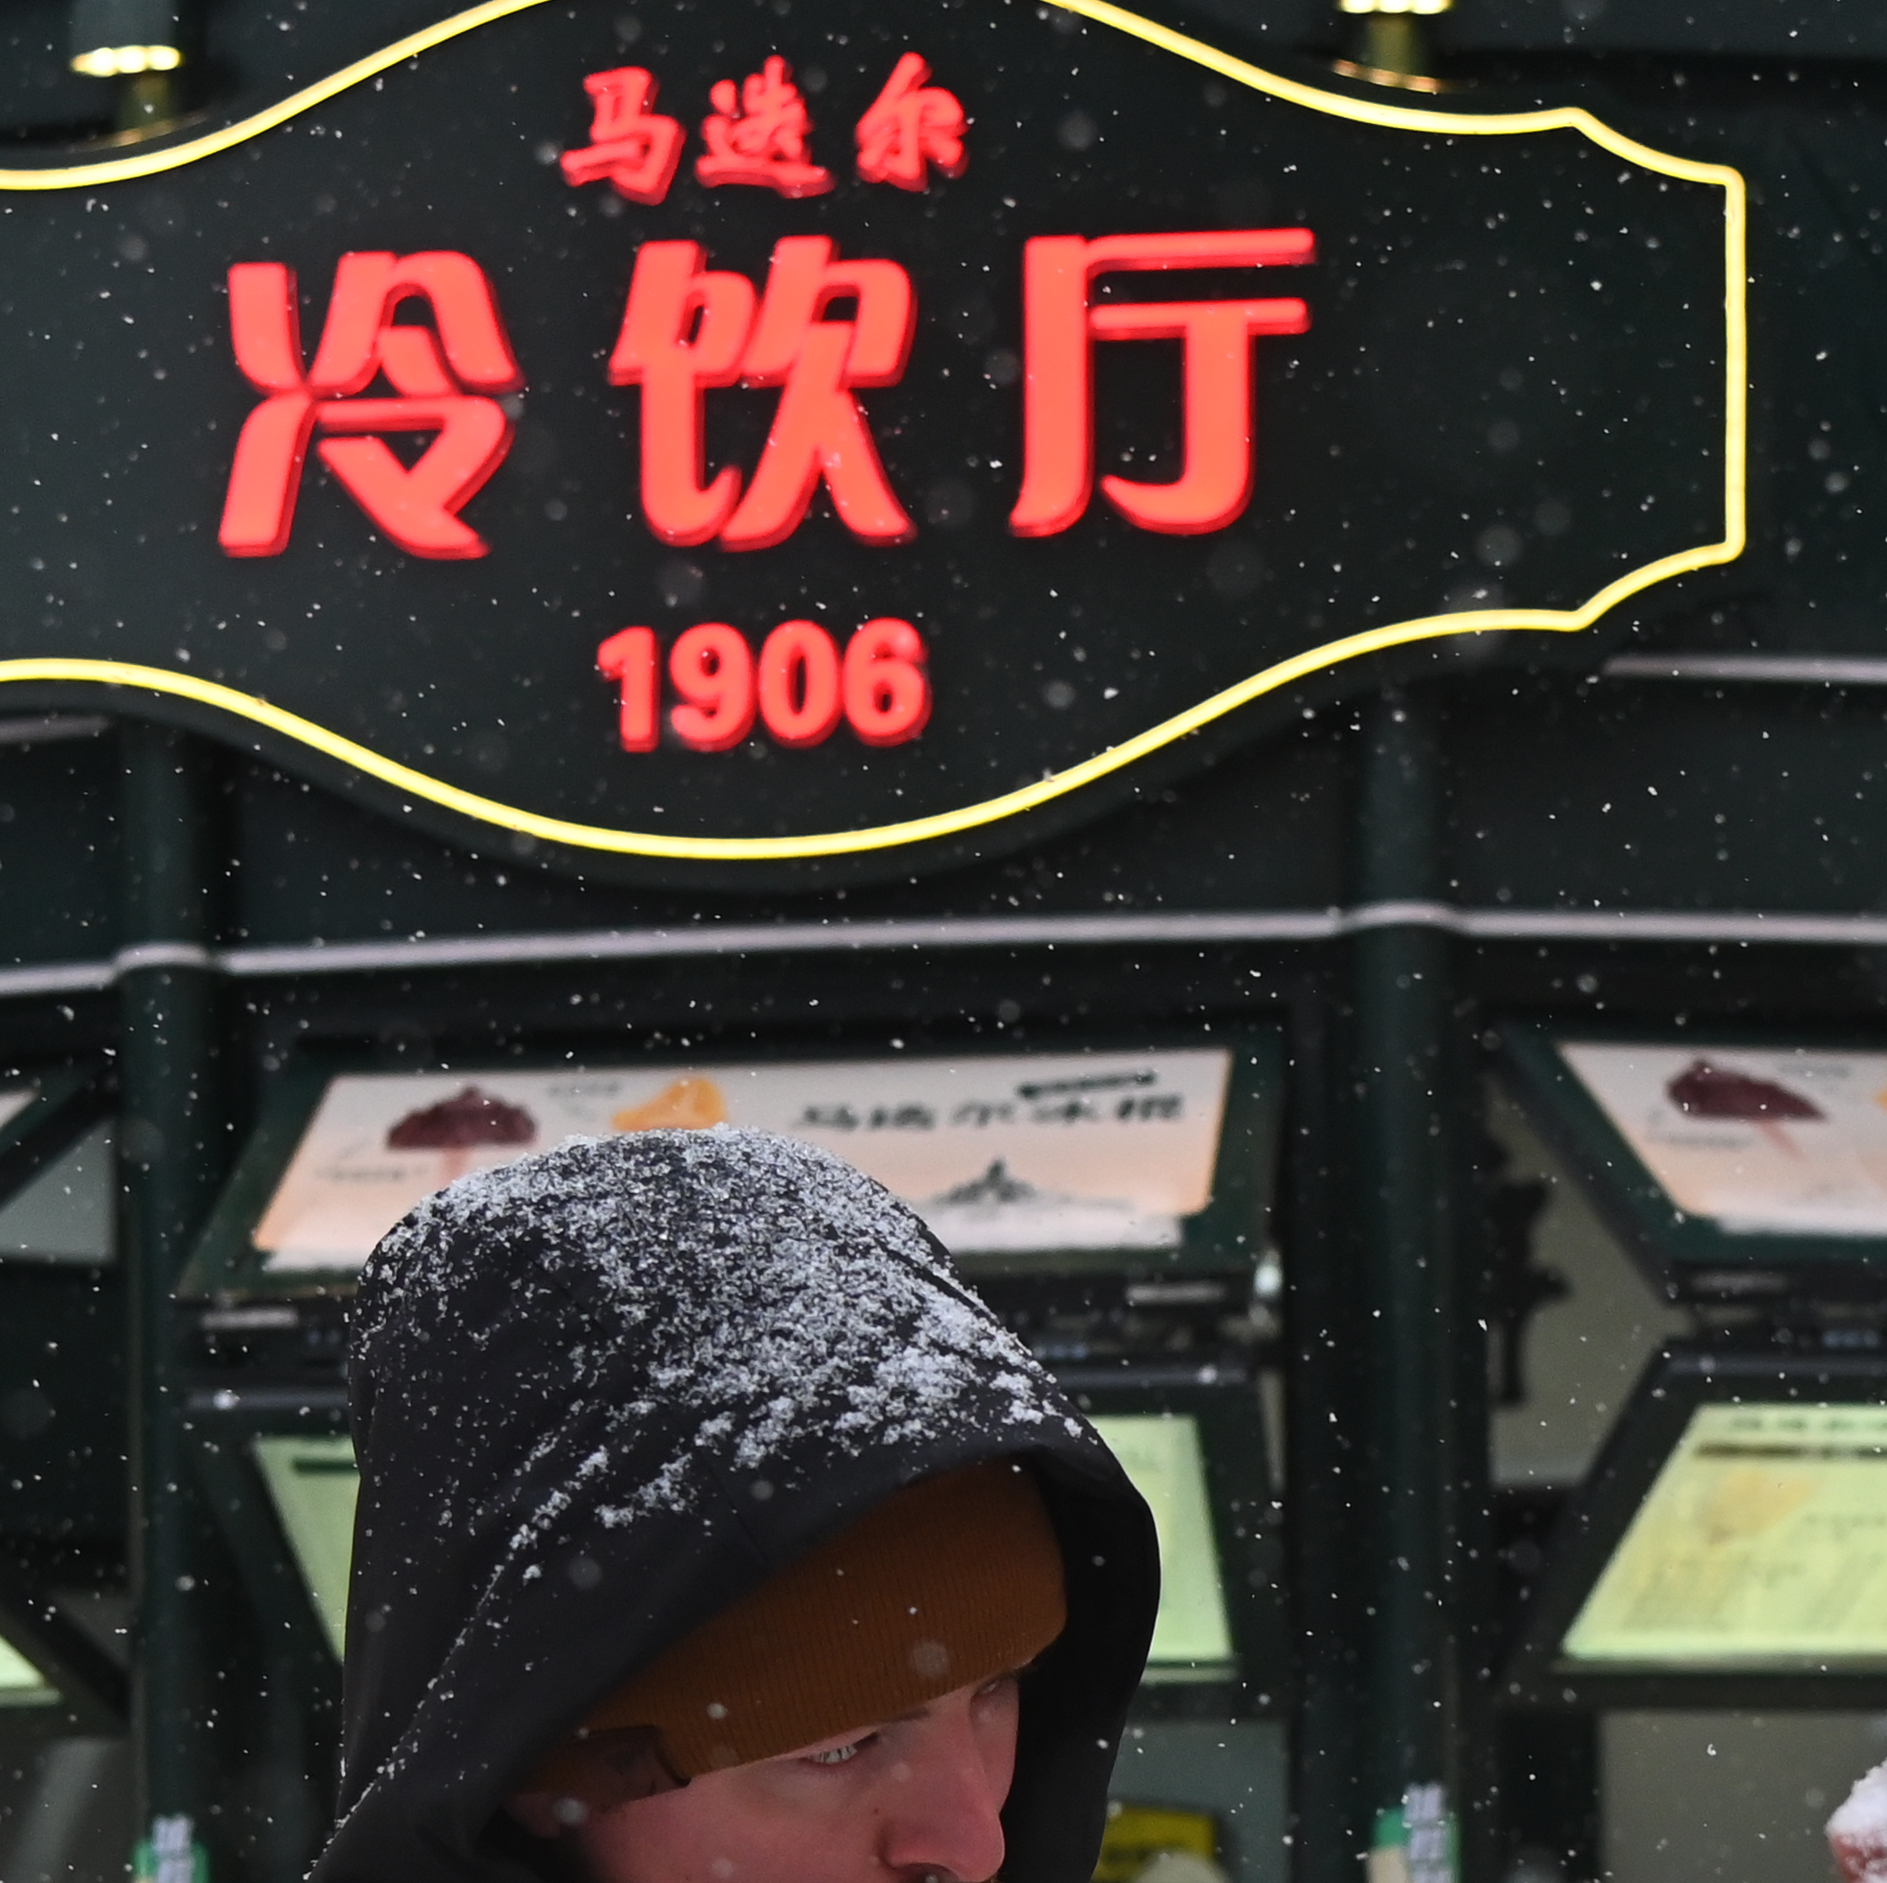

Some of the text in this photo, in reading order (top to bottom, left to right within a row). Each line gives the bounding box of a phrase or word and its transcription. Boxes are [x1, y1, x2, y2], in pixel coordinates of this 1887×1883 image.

[559, 52, 969, 206] 马迭尔
[218, 228, 1315, 560] 冷饮厅
[597, 617, 931, 752] 1906
